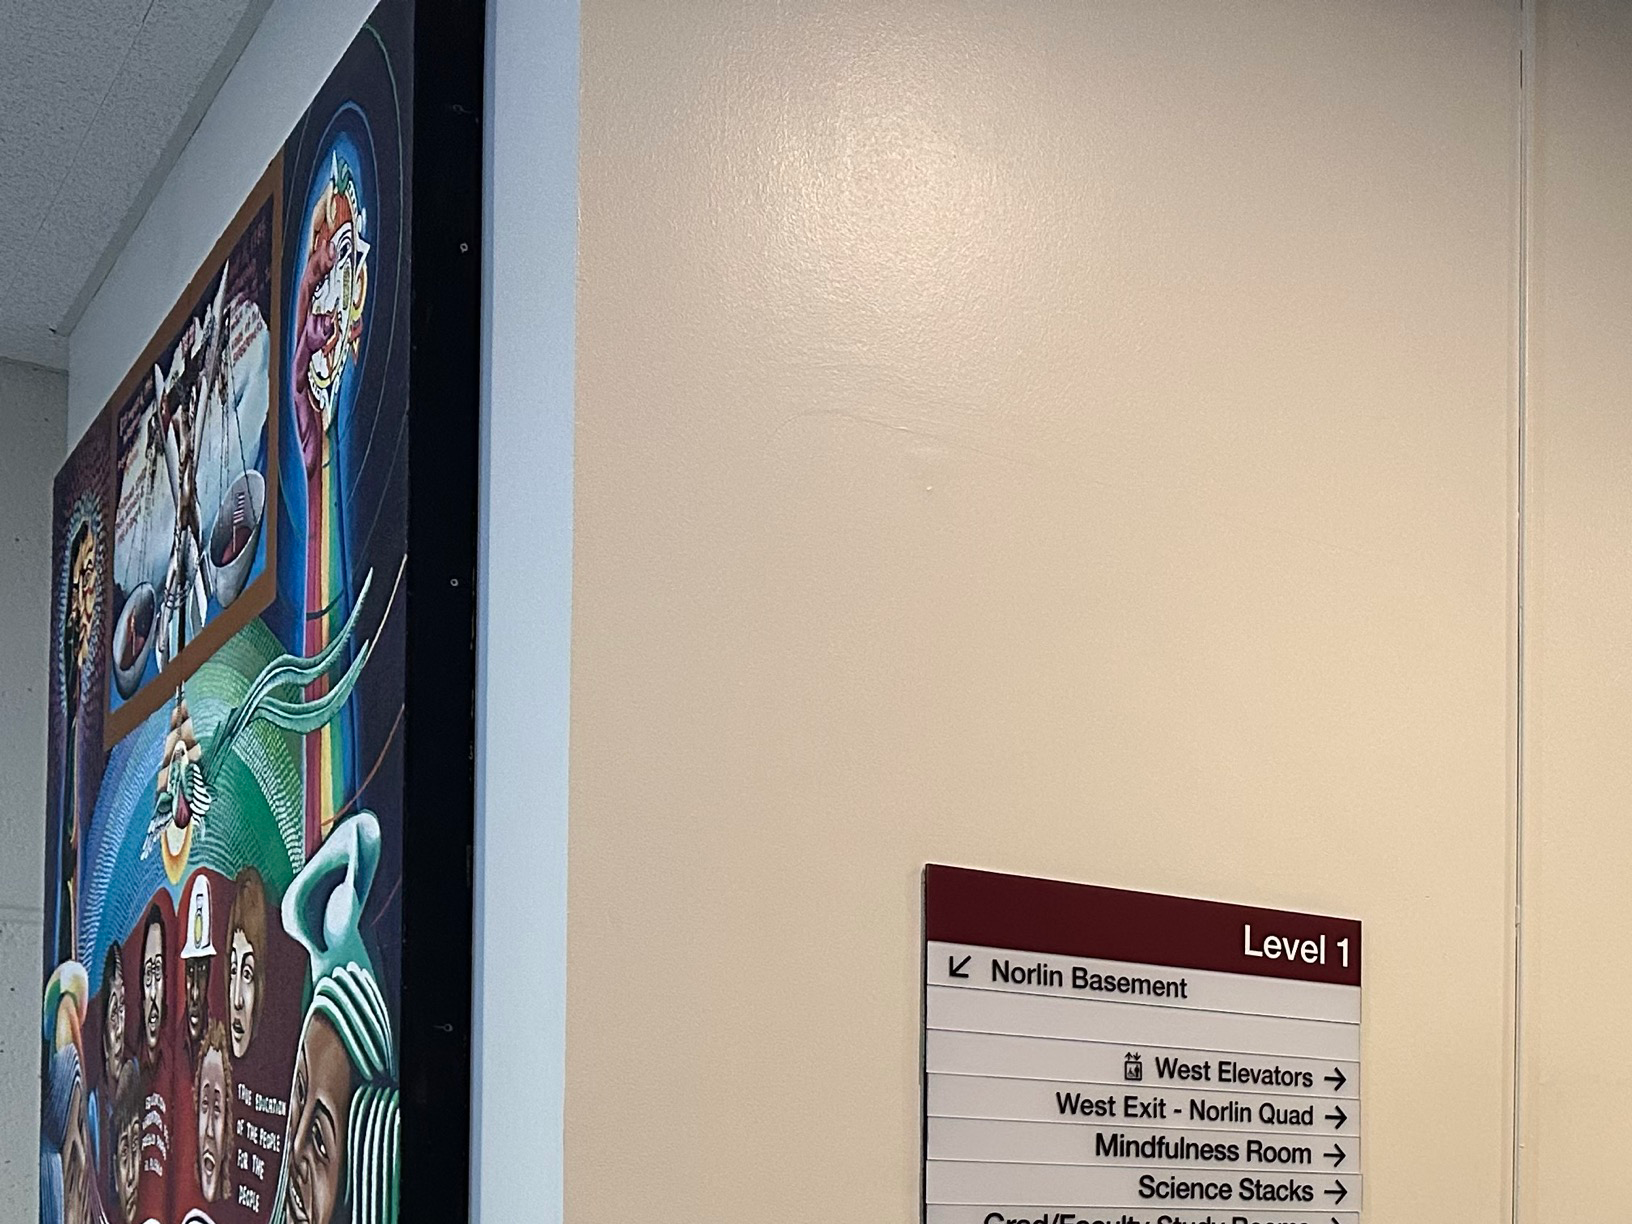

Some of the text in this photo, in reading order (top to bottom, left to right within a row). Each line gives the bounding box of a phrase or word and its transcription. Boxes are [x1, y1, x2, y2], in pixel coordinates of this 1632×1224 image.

[1243, 924, 1350, 968] Level 1
[991, 959, 1188, 999] Norlin Basement
[1154, 1057, 1314, 1088] West Elevators
[238, 1083, 286, 1116] TRUE EDUCATION
[1056, 1091, 1116, 1117] West
[1123, 1095, 1167, 1119] Exit
[1189, 1099, 1252, 1123] Norlin
[1258, 1102, 1314, 1127] Quad
[237, 1119, 280, 1152] OF THE PEOPLE
[1094, 1133, 1312, 1164] Mindfulness Room
[237, 1148, 265, 1180] FOR THE
[238, 1184, 260, 1213] PEOPLE
[1138, 1174, 1314, 1202] Science Stacks
